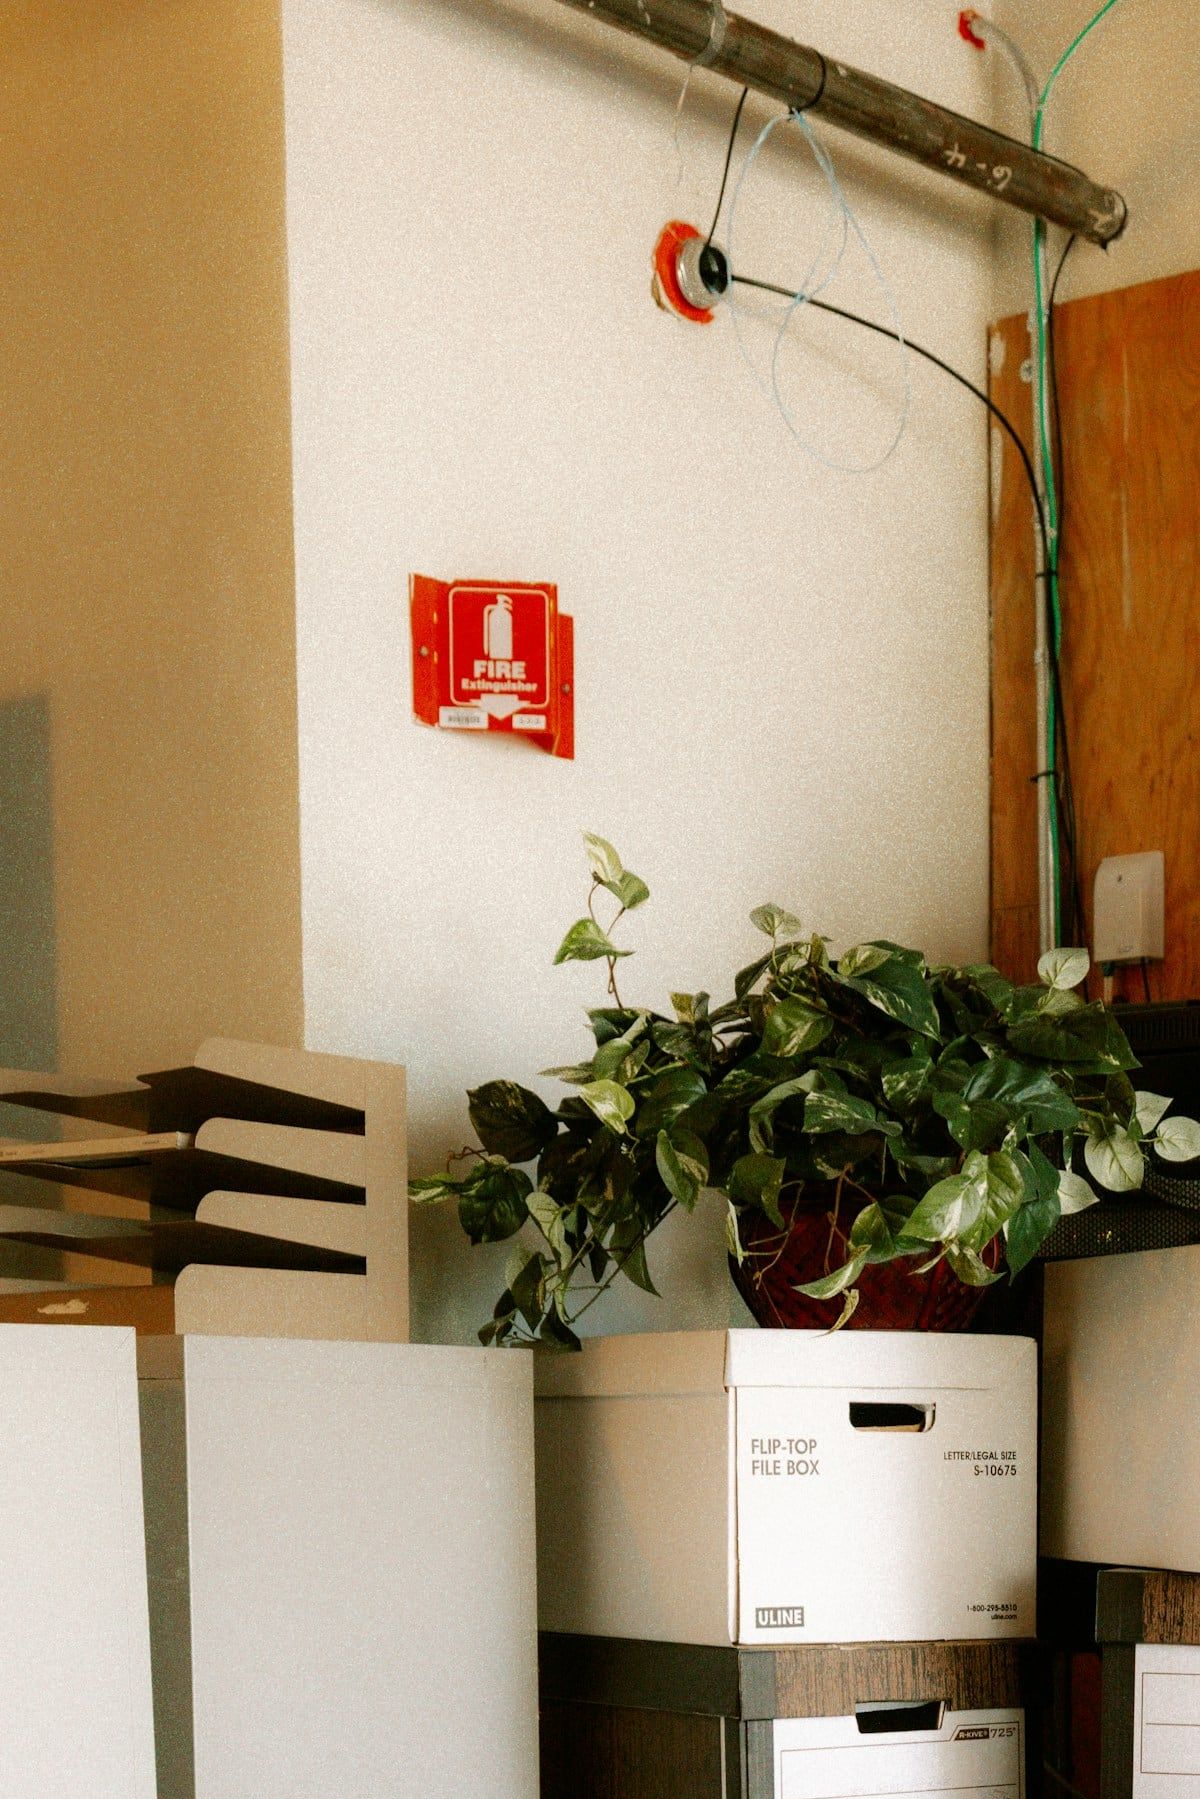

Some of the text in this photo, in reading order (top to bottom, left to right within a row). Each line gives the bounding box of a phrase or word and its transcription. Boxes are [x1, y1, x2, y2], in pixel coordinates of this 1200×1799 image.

[474, 659, 526, 679] FIRE
[461, 677, 538, 693] Extinguisher
[751, 1438, 817, 1455] FLIP-TOP
[943, 1451, 1017, 1461] LETTER/LEGAL SIZE
[752, 1460, 820, 1476] FILE BOX
[974, 1465, 1017, 1476] S-10675
[758, 1609, 804, 1627] ULINE
